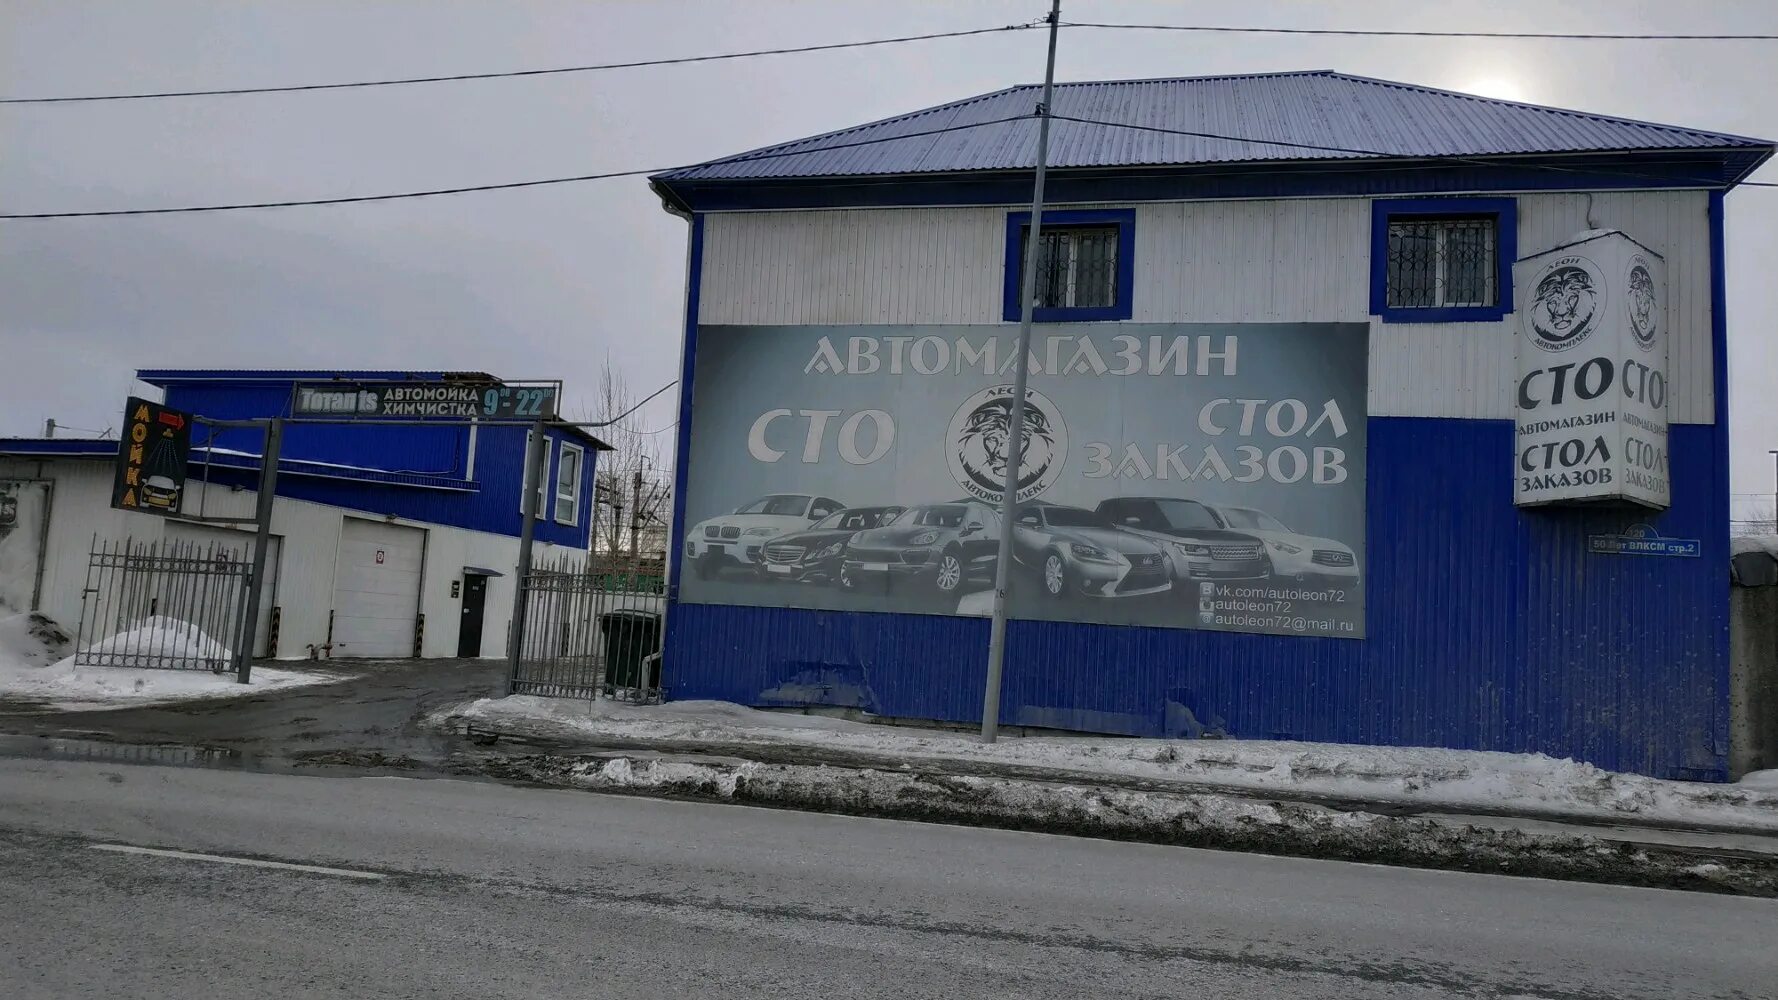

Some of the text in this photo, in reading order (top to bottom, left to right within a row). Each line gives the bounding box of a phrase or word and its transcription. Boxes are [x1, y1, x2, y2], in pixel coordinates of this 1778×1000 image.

[1546, 258, 1581, 273] ЛЕОН
[1535, 325, 1593, 350] АВТОКОМПЛЕКС
[804, 335, 1238, 376] АВТОМАГАЗИН
[383, 387, 479, 401] АВТОМОЙКА
[1518, 357, 1614, 410] СТО
[1622, 359, 1664, 409] СТО
[382, 401, 477, 416] ХИМЧИСТКА
[1198, 398, 1349, 438] СТОЛ
[1519, 411, 1615, 436] АВТОМАГАЗИН
[747, 408, 897, 465] СТО
[122, 404, 150, 507] МОЙКА
[1082, 442, 1348, 485] ЗАКАЗОВ
[1521, 435, 1611, 472] СТОЛ
[1625, 437, 1664, 473] СТОЛ
[962, 480, 1046, 502] АВТОКОЛЕКС
[1521, 467, 1612, 492] ЗАКАЗОВ
[1625, 468, 1665, 494] ЗАКАЗОВ
[1629, 541, 1665, 551] ВЛКСМ
[1668, 543, 1694, 554] стр.2
[1215, 599, 1292, 613] autoleon72
[1216, 585, 1345, 602] vk.com/autoleon72
[1215, 614, 1354, 632] autoleon72@mail.ru
